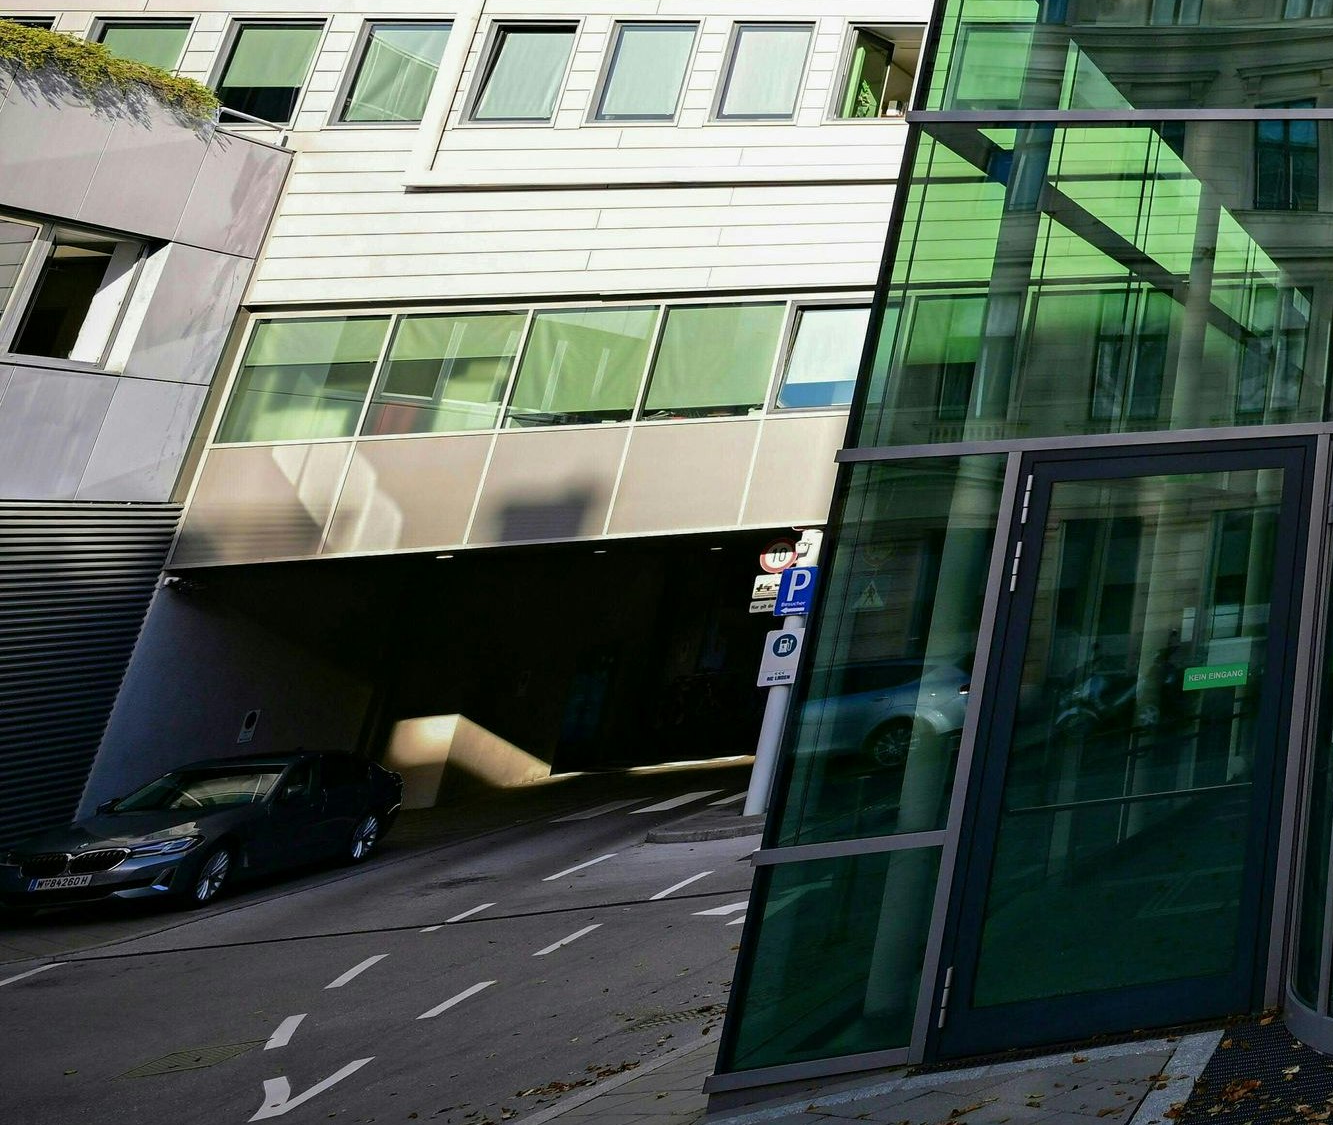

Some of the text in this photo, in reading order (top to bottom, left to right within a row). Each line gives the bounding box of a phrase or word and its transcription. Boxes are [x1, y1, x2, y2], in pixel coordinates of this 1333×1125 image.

[771, 547, 788, 563] 10
[786, 569, 812, 602] P
[1188, 669, 1243, 682] KEIN EINGANG
